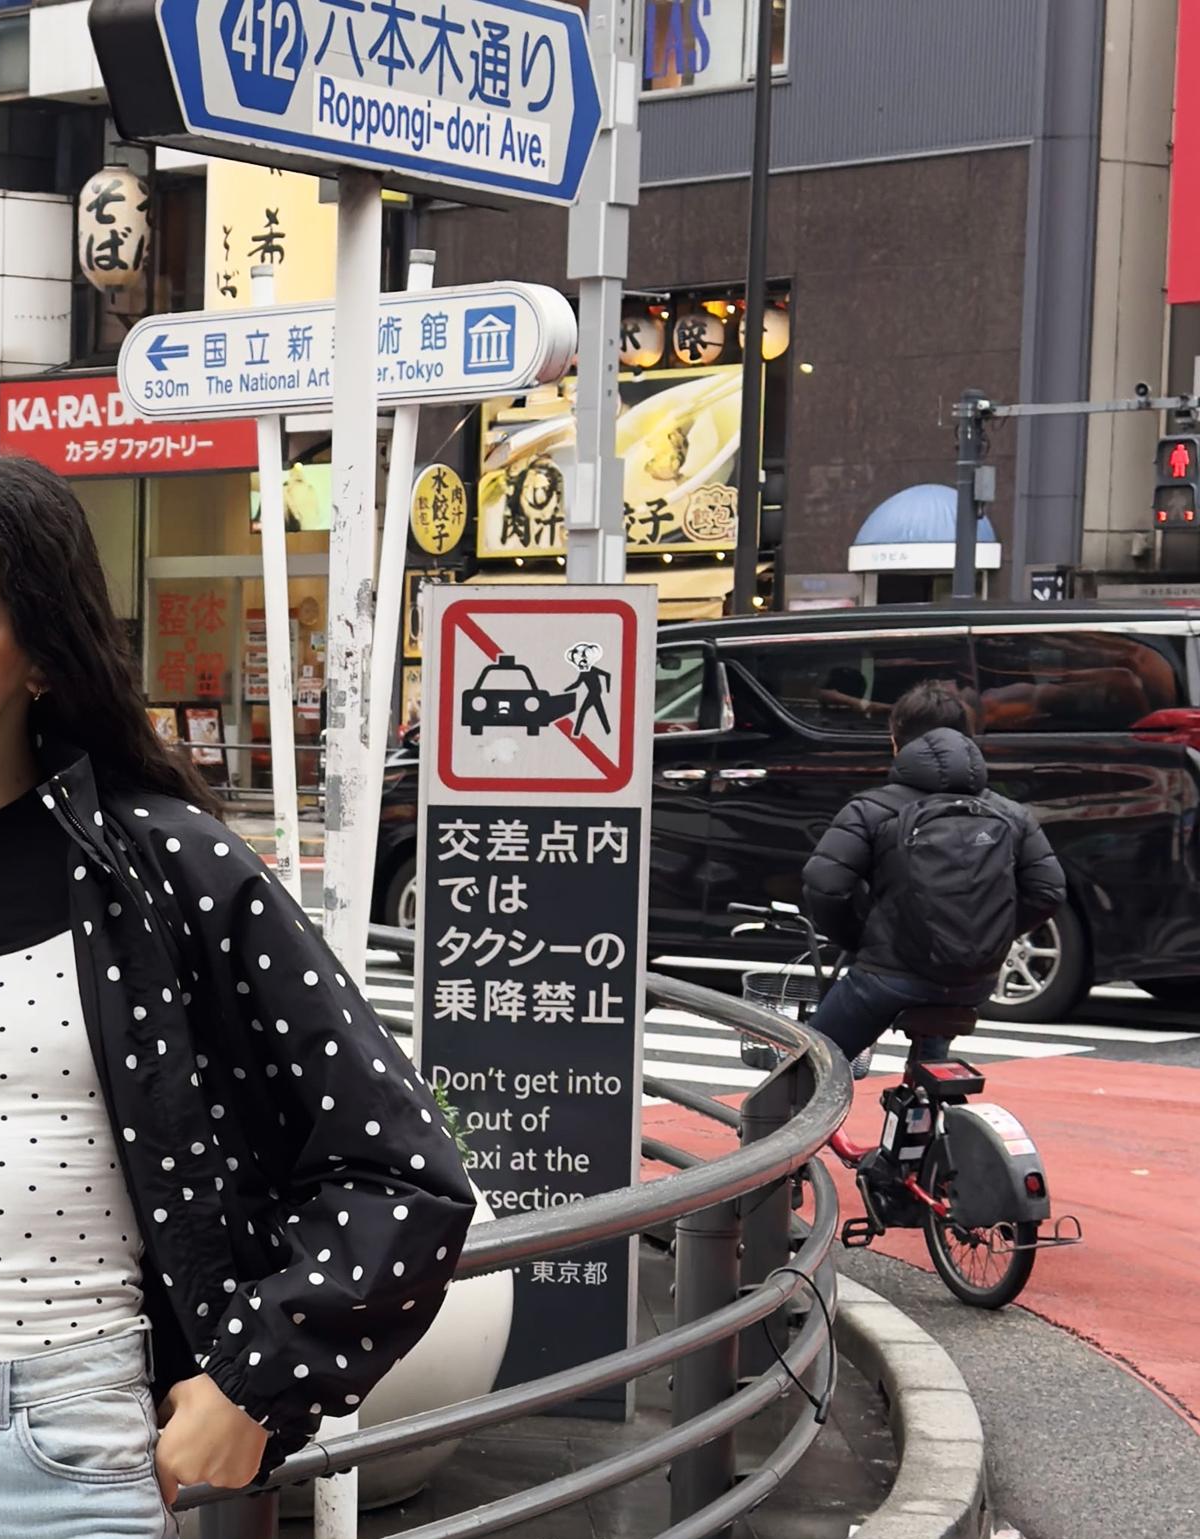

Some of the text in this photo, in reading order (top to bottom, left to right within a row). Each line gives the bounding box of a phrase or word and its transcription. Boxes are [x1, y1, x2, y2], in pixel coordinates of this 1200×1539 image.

[231, 0, 298, 82] 412
[314, 0, 557, 113] 六本木通り
[318, 76, 546, 168] Roppongi-dori Ave.
[86, 179, 132, 271] そば
[203, 311, 449, 369] 国立新術館
[144, 380, 190, 399] 530m
[206, 375, 233, 395] The
[239, 370, 300, 393] National
[307, 366, 331, 388] Art
[396, 360, 444, 383] Tokyo
[65, 434, 214, 463] カラダファクトリー
[437, 819, 629, 865] 交差点内
[438, 875, 529, 914] では
[436, 926, 626, 970] タクシーの
[433, 979, 625, 1024] 乗降禁止
[514, 1070, 559, 1099] get
[568, 1069, 622, 1095] into
[466, 1106, 550, 1132] out of
[465, 1145, 590, 1173] axi at the
[482, 1185, 584, 1210] rsection
